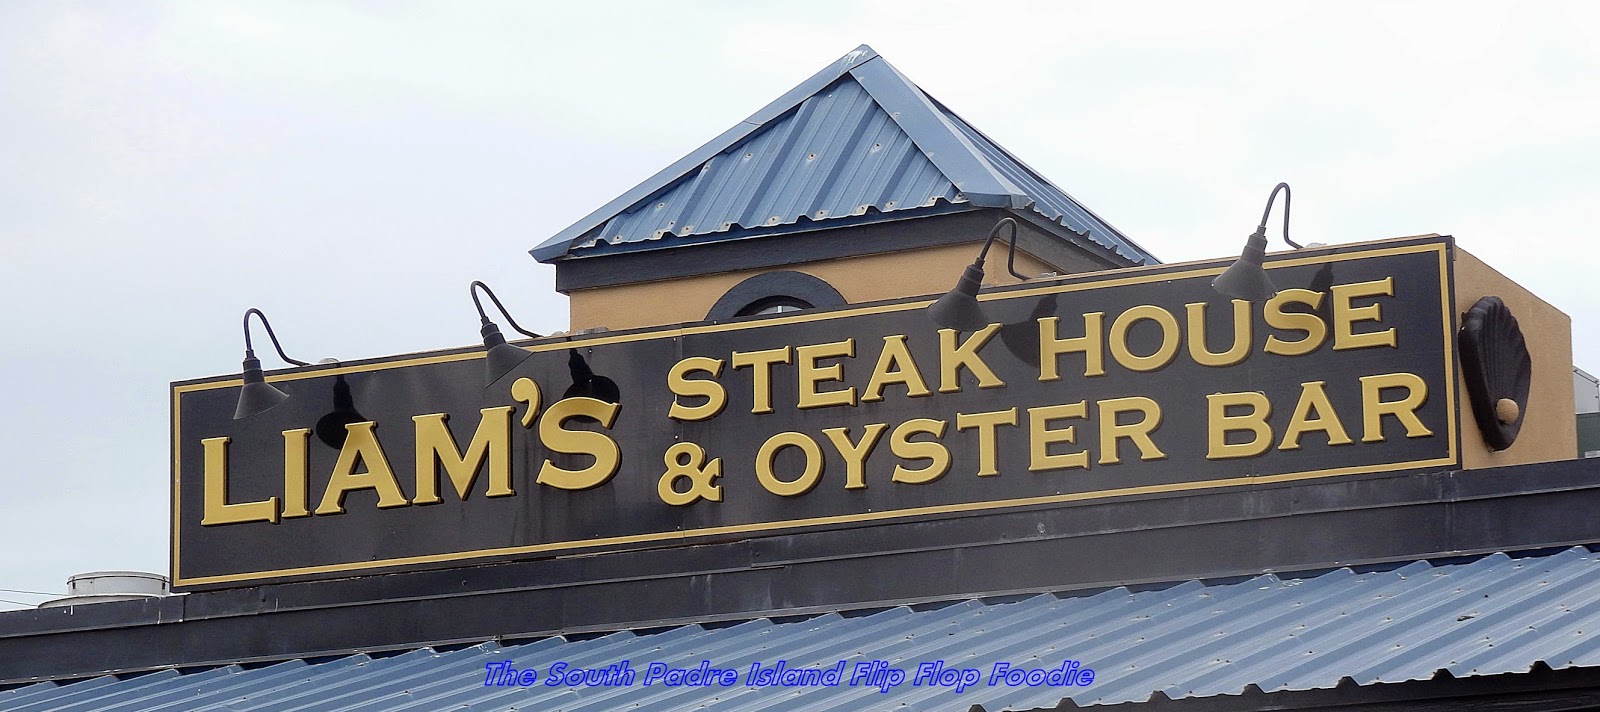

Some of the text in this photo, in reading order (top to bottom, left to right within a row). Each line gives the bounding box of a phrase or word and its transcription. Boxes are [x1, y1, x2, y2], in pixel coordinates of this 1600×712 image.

[667, 276, 1397, 421] STEAK HOUSE
[200, 377, 621, 526] LIAM'S
[657, 372, 1432, 506] & OYSTER BAR
